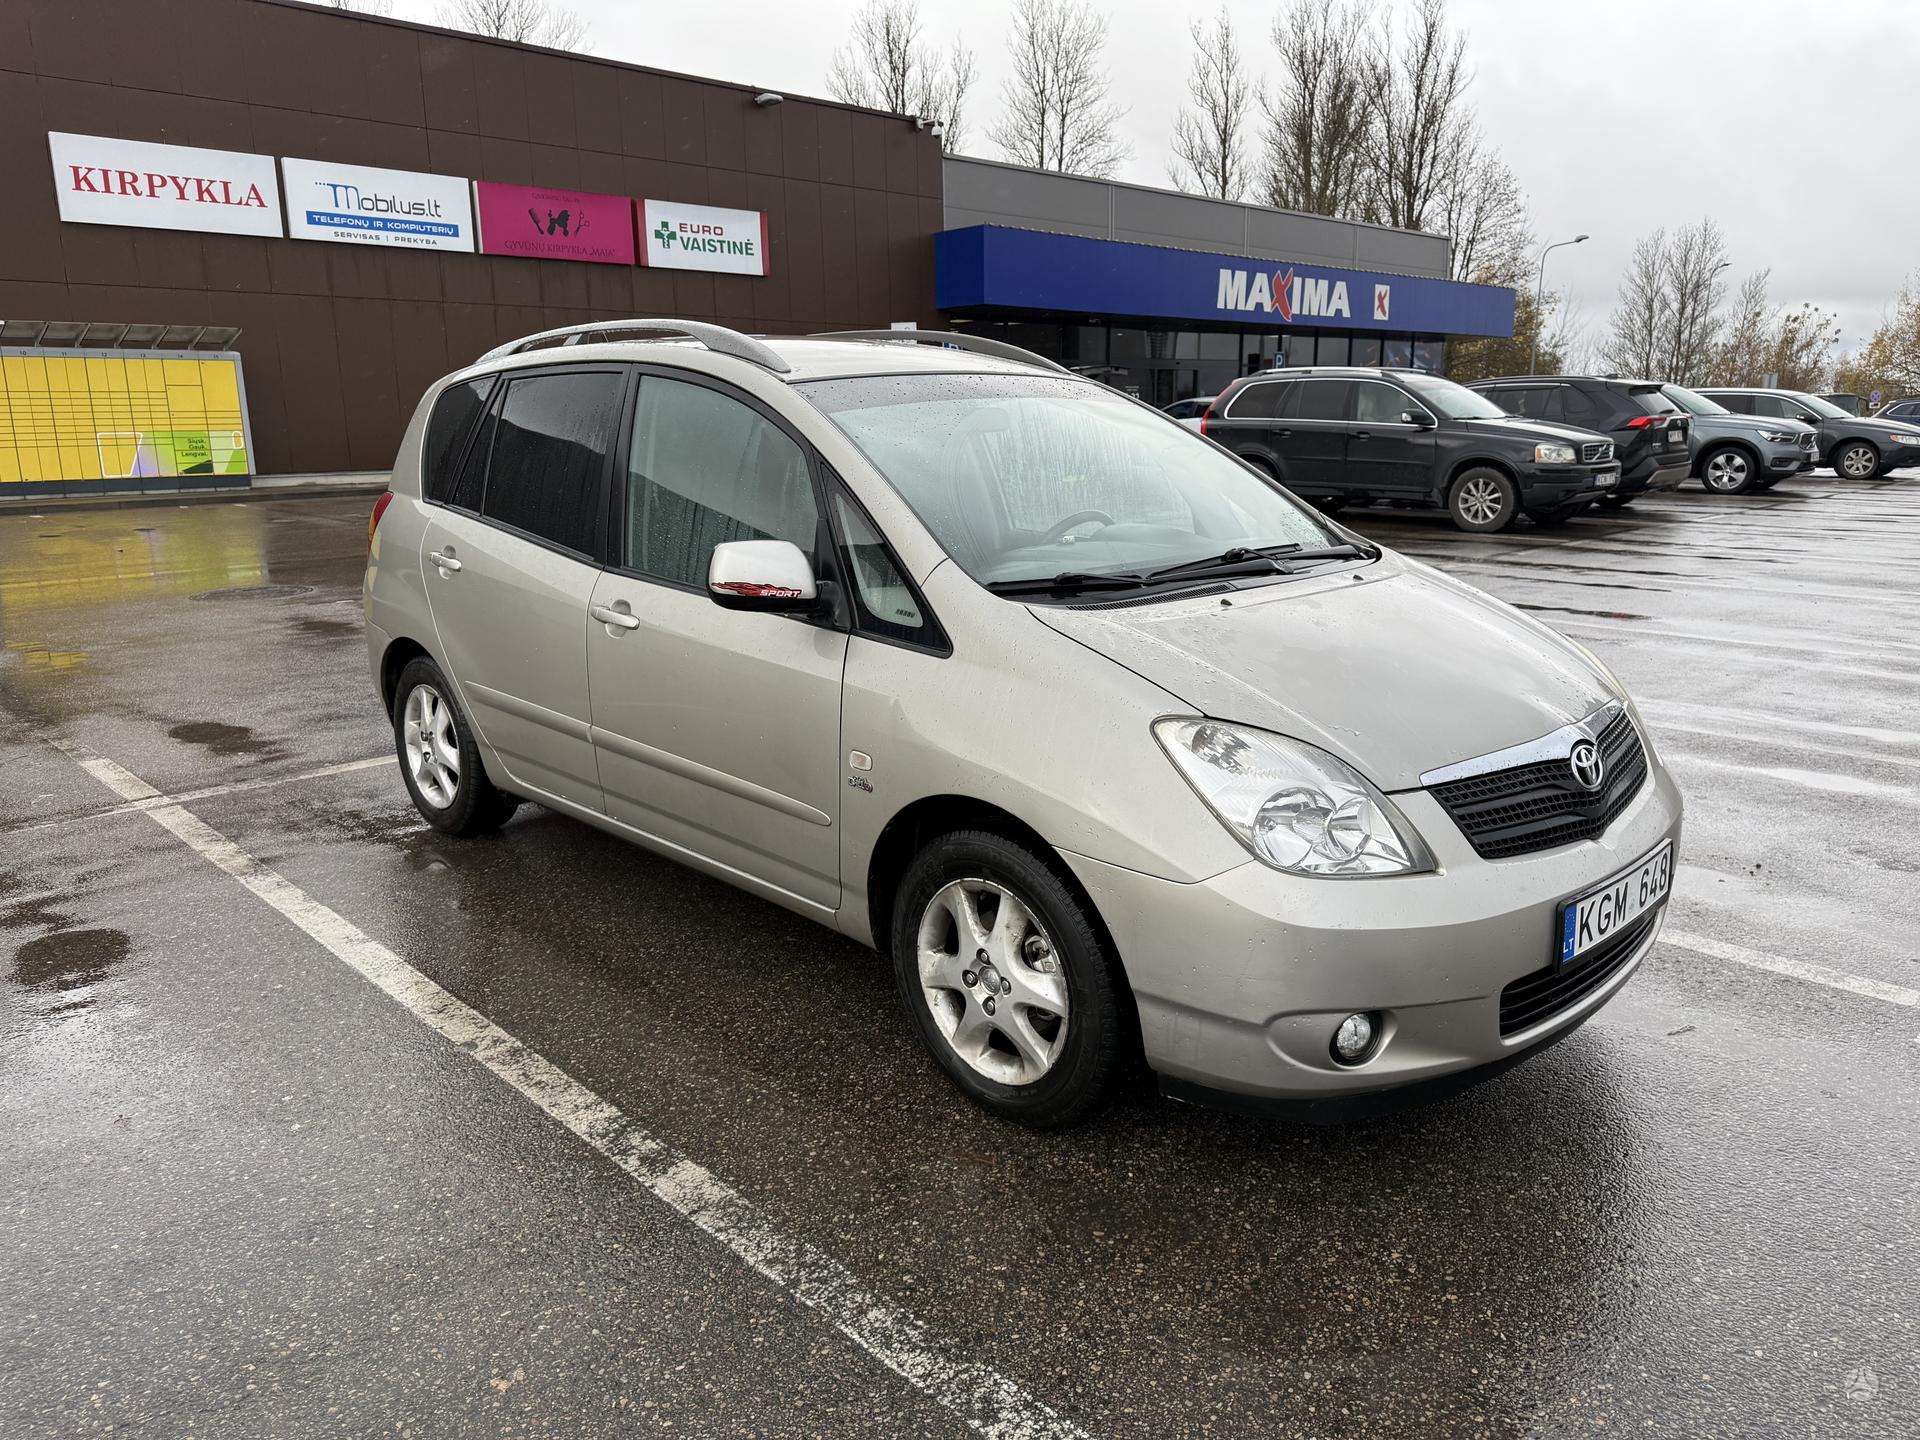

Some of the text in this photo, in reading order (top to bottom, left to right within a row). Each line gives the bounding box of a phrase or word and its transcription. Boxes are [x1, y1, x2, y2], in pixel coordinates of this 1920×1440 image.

[69, 165, 268, 208] KIRPYKLA
[313, 215, 369, 228] TELEFONŲ
[387, 222, 454, 235] KOMPIUTERIŲ
[679, 223, 724, 236] EURO
[334, 231, 437, 245] SERVISAS PREKYBA
[680, 236, 754, 256] VAISTINĖ
[1217, 267, 1351, 322] MAXIMA
[760, 589, 800, 598] SPORT
[1563, 852, 1668, 953] LT KGM 648
